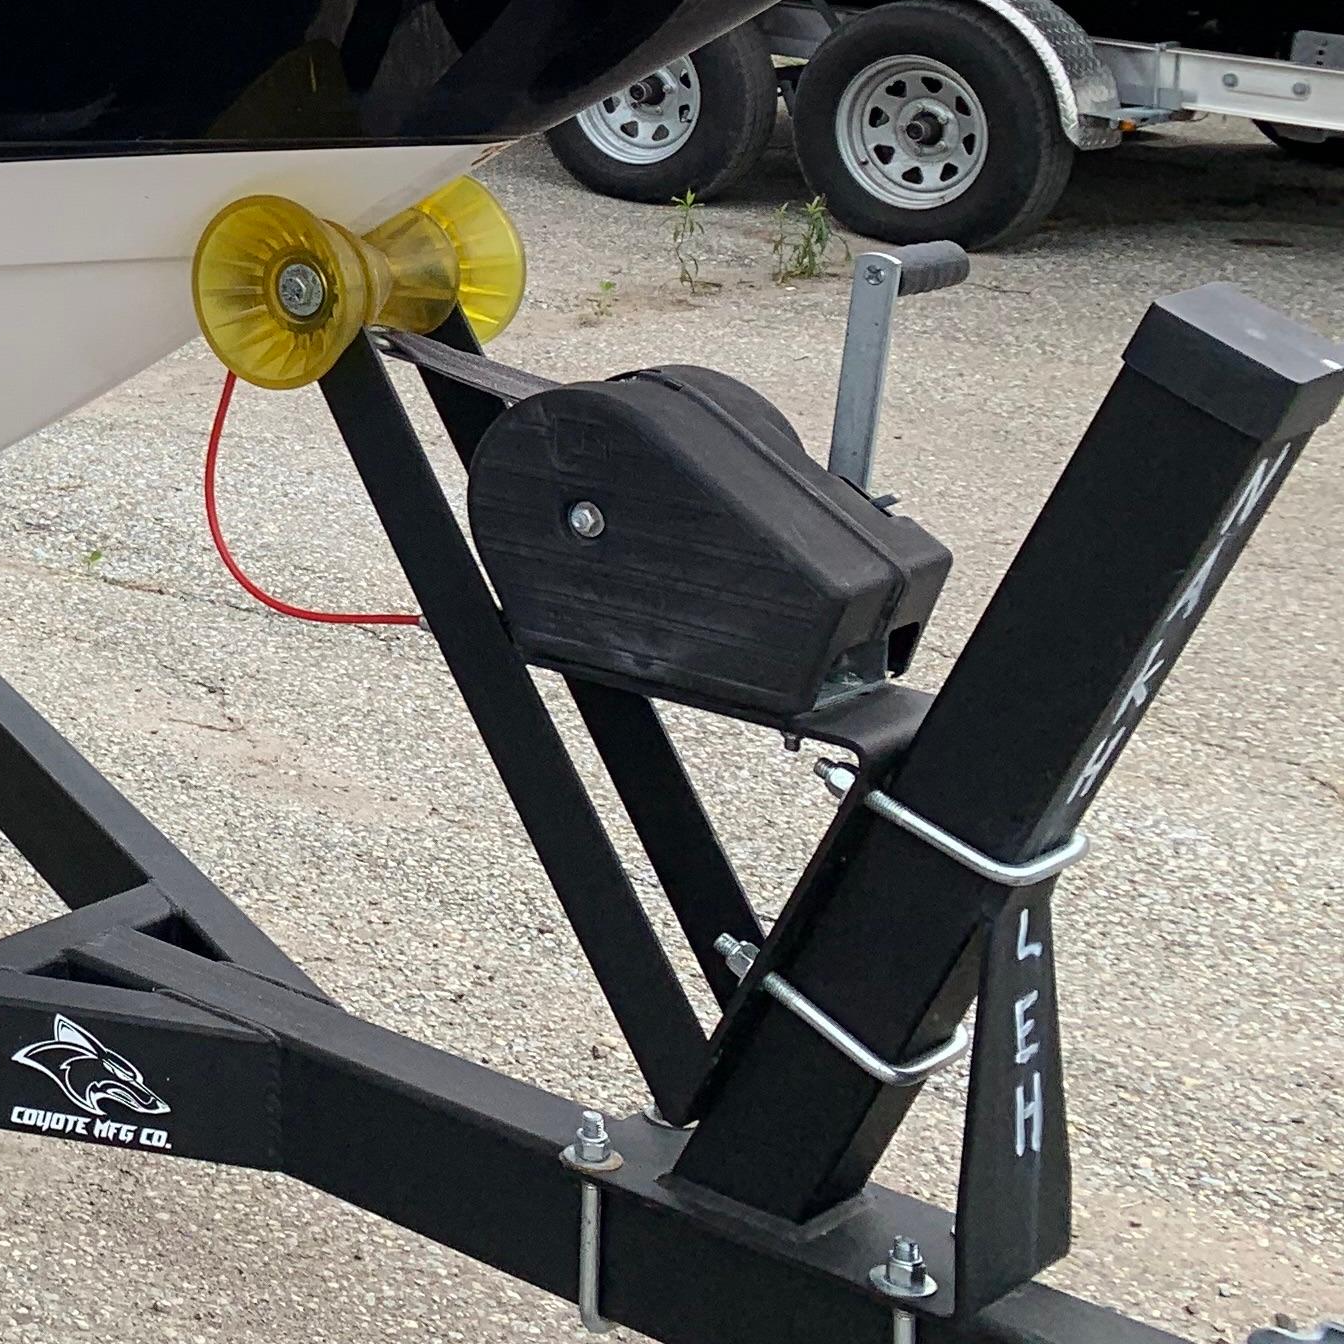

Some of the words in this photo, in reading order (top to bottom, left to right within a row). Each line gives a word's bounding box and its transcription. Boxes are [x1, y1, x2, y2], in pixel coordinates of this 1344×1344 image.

[11, 1106, 91, 1135] COYOTE
[92, 1118, 139, 1143] MFG
[139, 1128, 173, 1149] CO.
